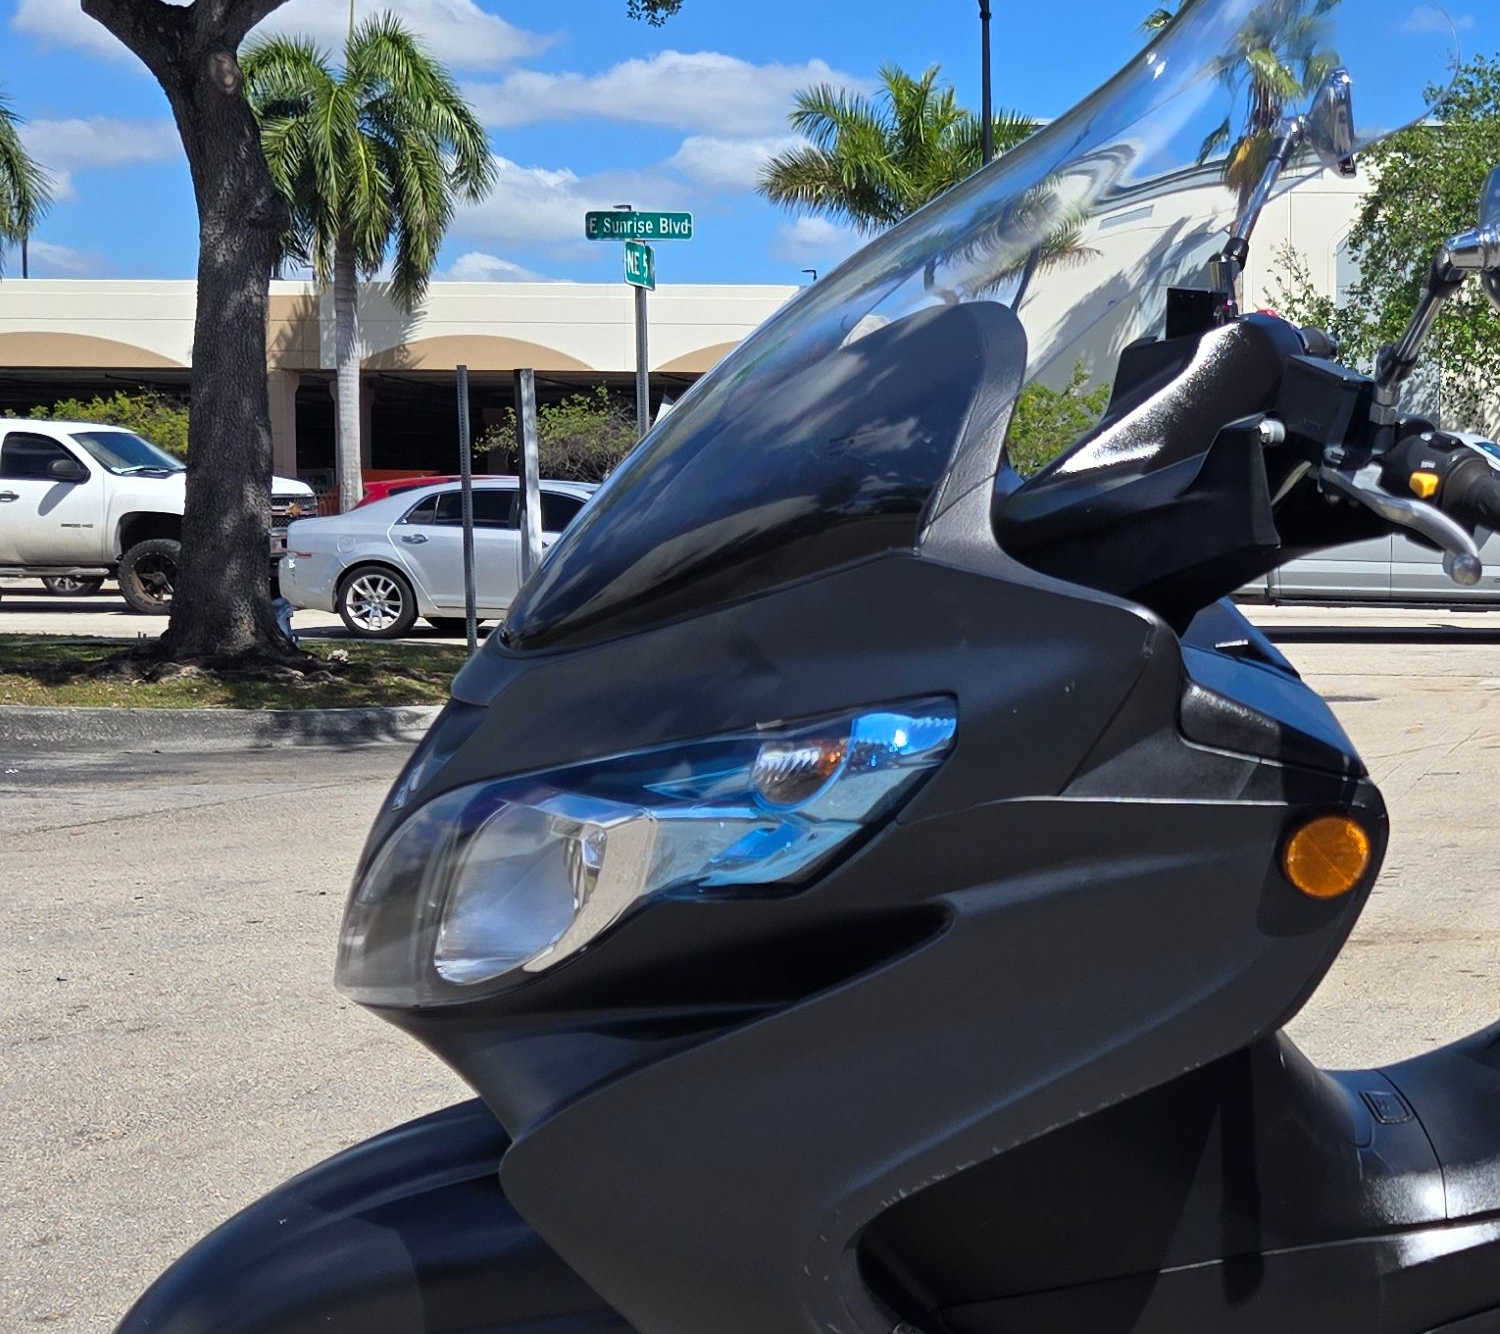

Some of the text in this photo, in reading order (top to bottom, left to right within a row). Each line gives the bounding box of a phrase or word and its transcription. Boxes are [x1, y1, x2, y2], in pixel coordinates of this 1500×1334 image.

[589, 217, 689, 234] E Sunrise Blvd
[626, 249, 640, 276] NE
